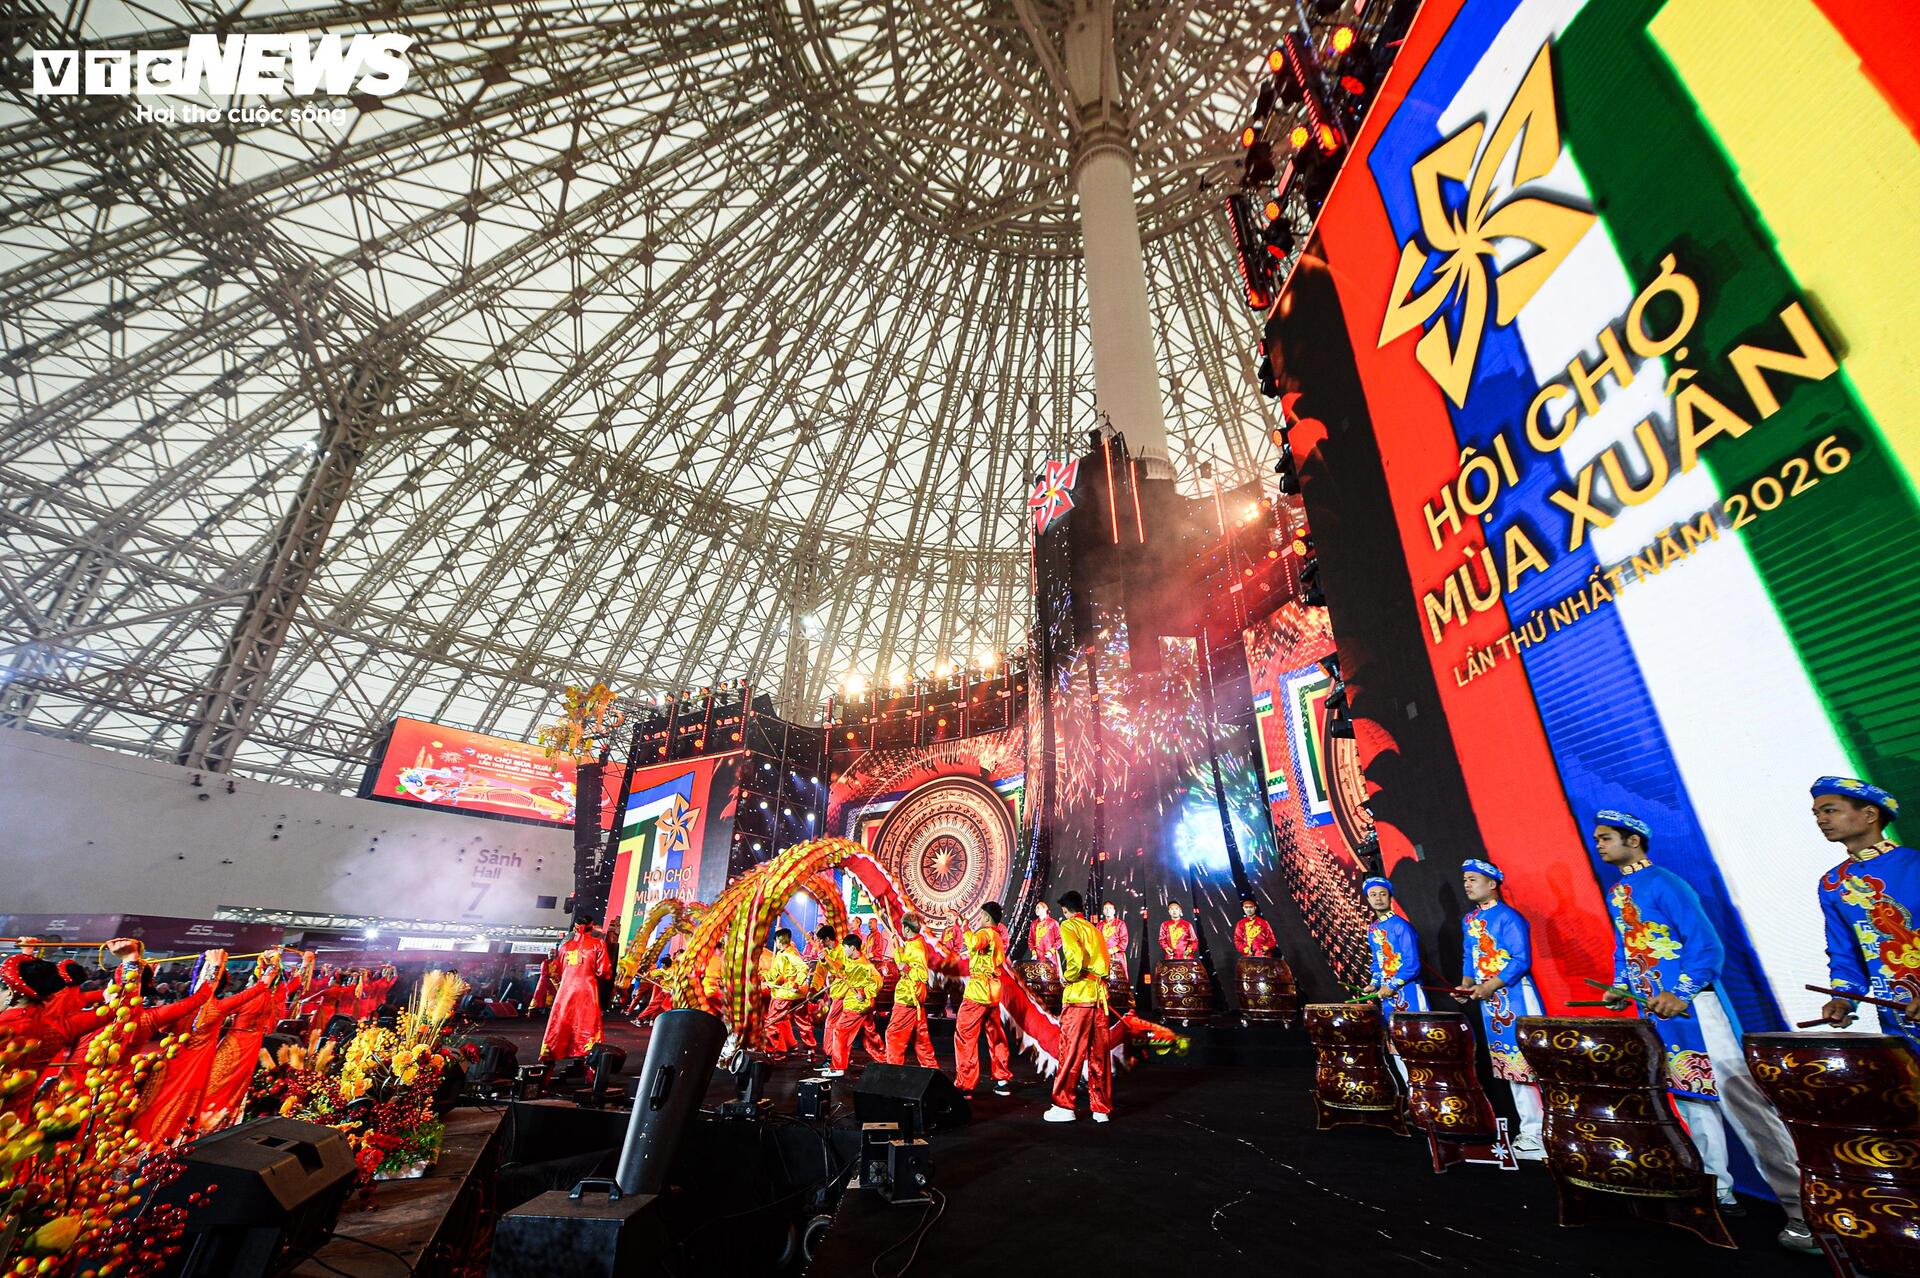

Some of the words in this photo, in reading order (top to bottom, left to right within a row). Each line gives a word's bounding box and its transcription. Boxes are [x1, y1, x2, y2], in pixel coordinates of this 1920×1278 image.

[1423, 434, 1520, 551] HỘI
[1526, 252, 1700, 453] CHỢ
[1423, 525, 1550, 645] MÙA
[1550, 301, 1840, 553] XUÂN
[1453, 645, 1496, 688] LẦN
[1495, 609, 1548, 661] THỨ
[1550, 564, 1625, 633] NHẤT
[1630, 511, 1720, 584] NĂM
[1723, 435, 1851, 530] 2026
[468, 881, 491, 911] 7
[472, 866, 502, 879] Hall
[477, 849, 522, 868] Sảnh
